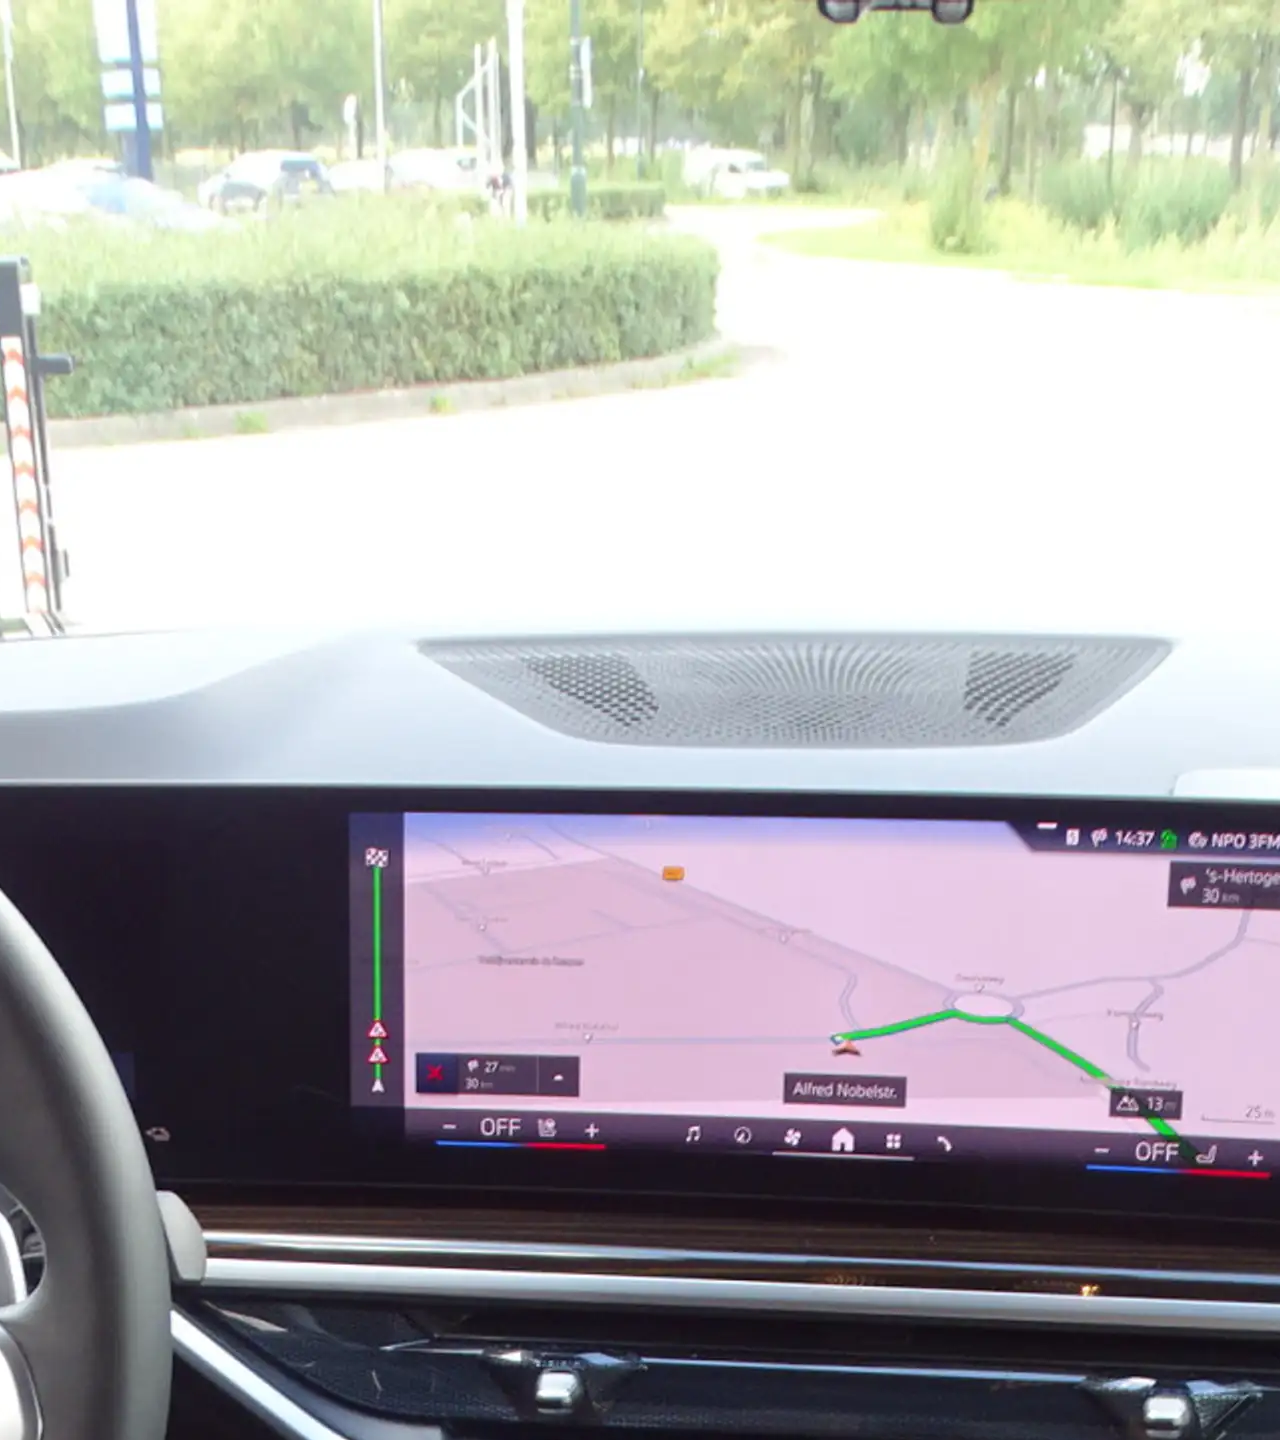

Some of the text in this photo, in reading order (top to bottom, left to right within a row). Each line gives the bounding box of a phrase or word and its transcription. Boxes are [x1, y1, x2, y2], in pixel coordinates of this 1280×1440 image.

[1115, 830, 1155, 846] 14:37
[1211, 832, 1280, 850] NPO 3FM
[1202, 887, 1219, 903] 30
[484, 1060, 499, 1074] 27
[465, 1077, 480, 1090] 30
[793, 1080, 898, 1100] Alfred Nobelstr.
[1147, 1096, 1164, 1112] 13
[1245, 1105, 1262, 1119] 25
[479, 1117, 522, 1137] OFF
[1135, 1141, 1180, 1161] OFF
